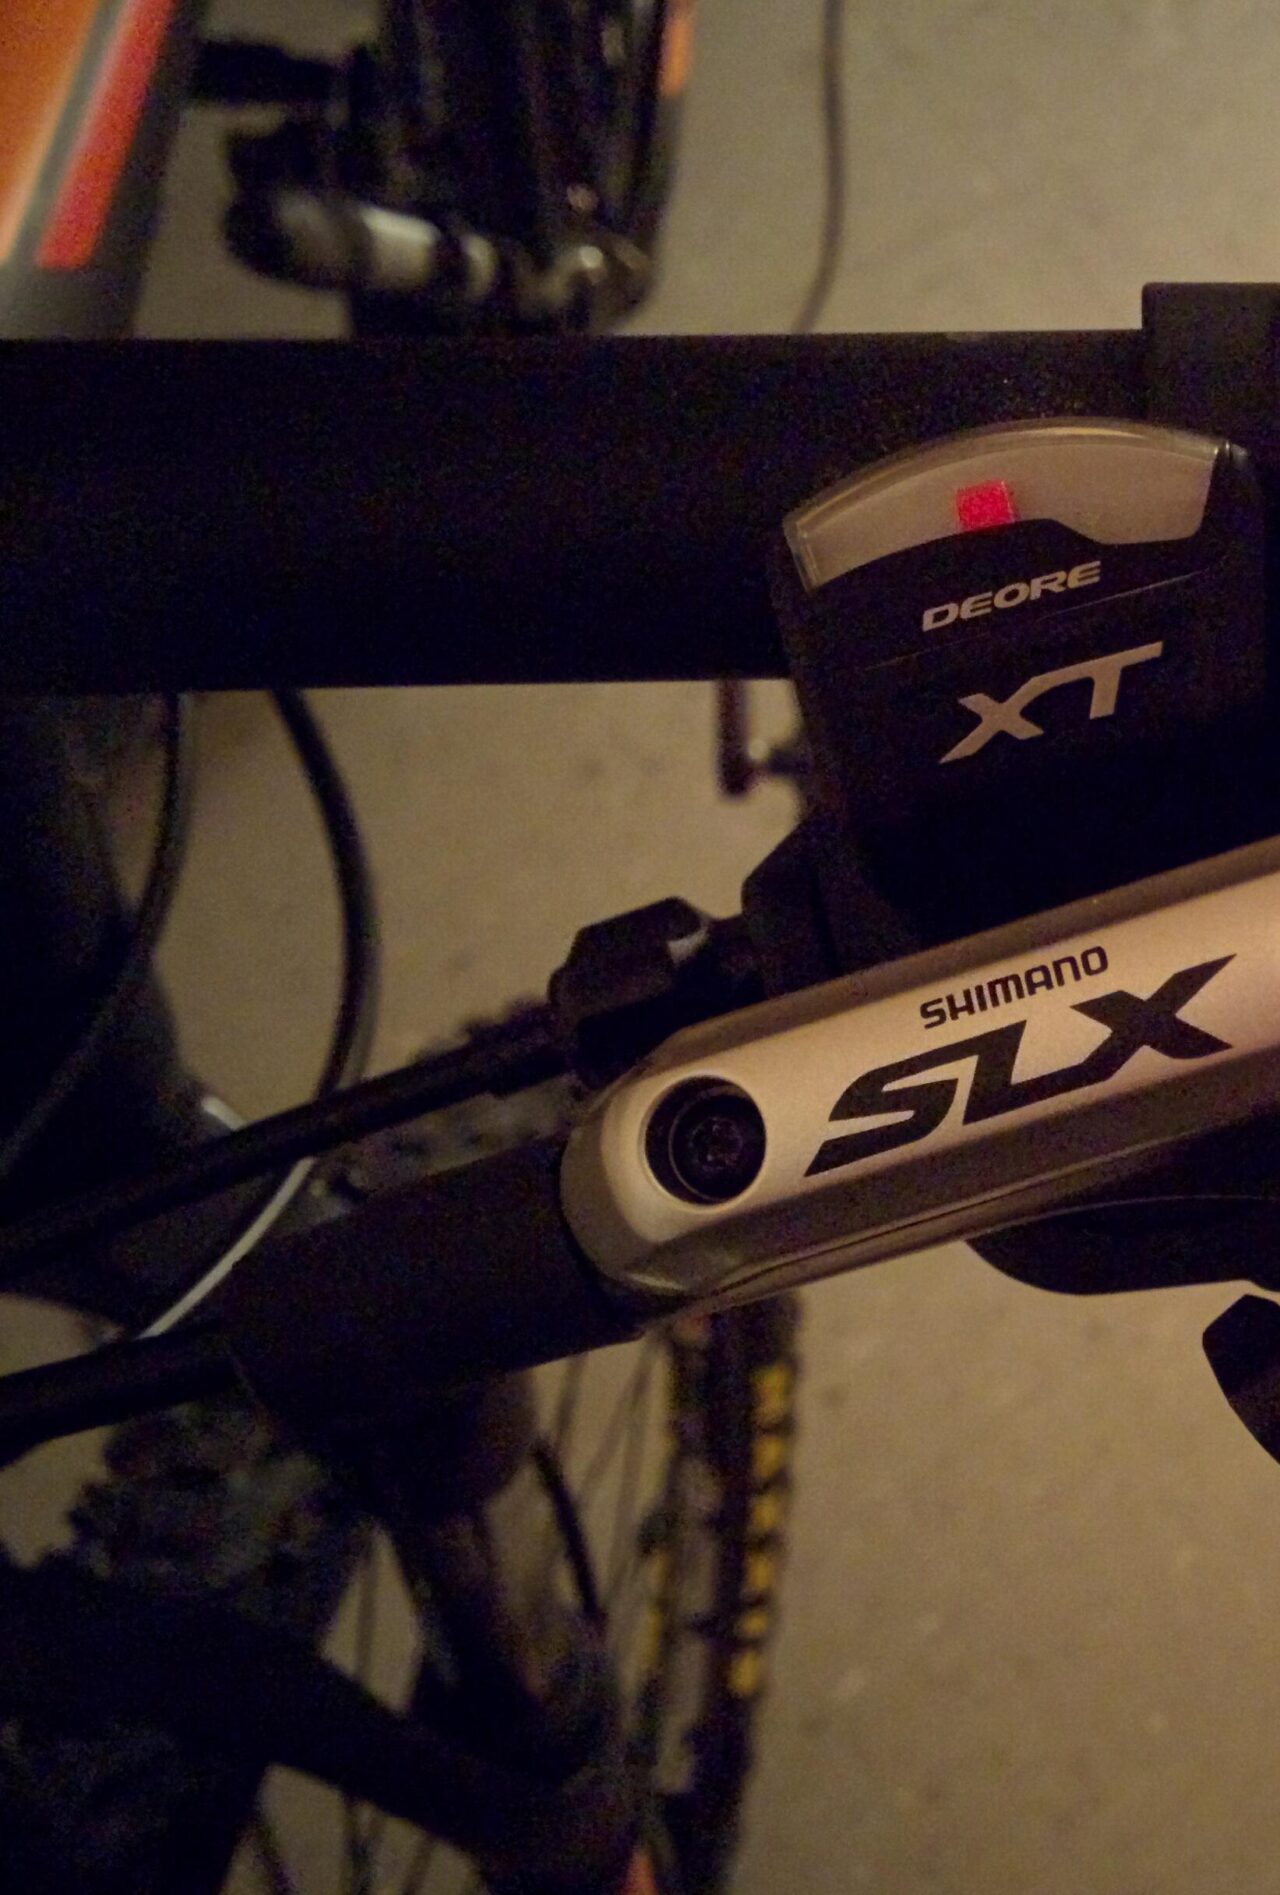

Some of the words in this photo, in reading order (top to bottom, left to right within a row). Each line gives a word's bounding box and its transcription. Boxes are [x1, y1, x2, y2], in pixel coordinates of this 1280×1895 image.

[921, 559, 1102, 633] DEORE
[938, 639, 1166, 766] XT
[919, 945, 1109, 1030] SHIMANO
[803, 953, 1238, 1178] SLX
